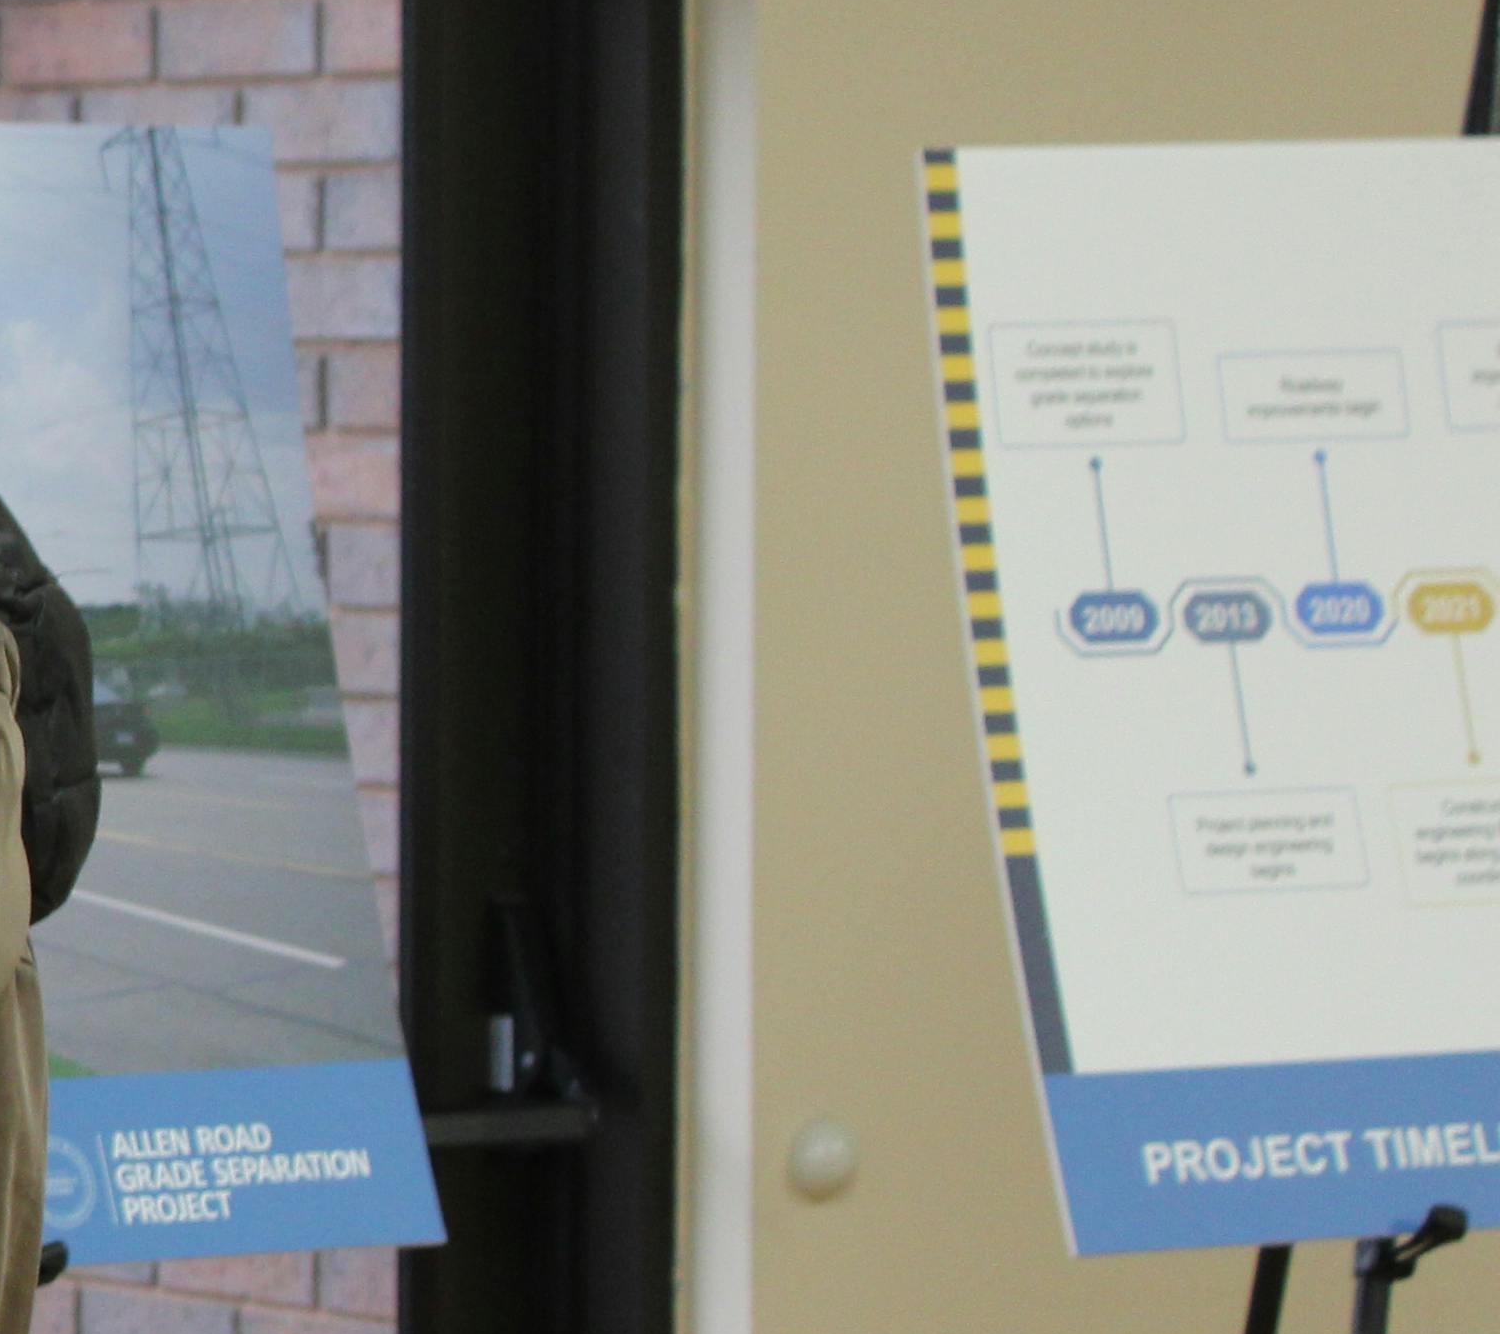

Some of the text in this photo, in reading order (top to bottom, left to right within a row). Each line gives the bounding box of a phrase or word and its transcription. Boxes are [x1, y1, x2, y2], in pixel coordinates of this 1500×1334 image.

[1081, 602, 1146, 633] 2009
[112, 1122, 272, 1160] ALLEN ROAD
[1141, 1121, 1500, 1185] PROJECT TIMEL
[116, 1148, 371, 1194] GRADE SEPARATION
[122, 1190, 232, 1225] PROJECT
